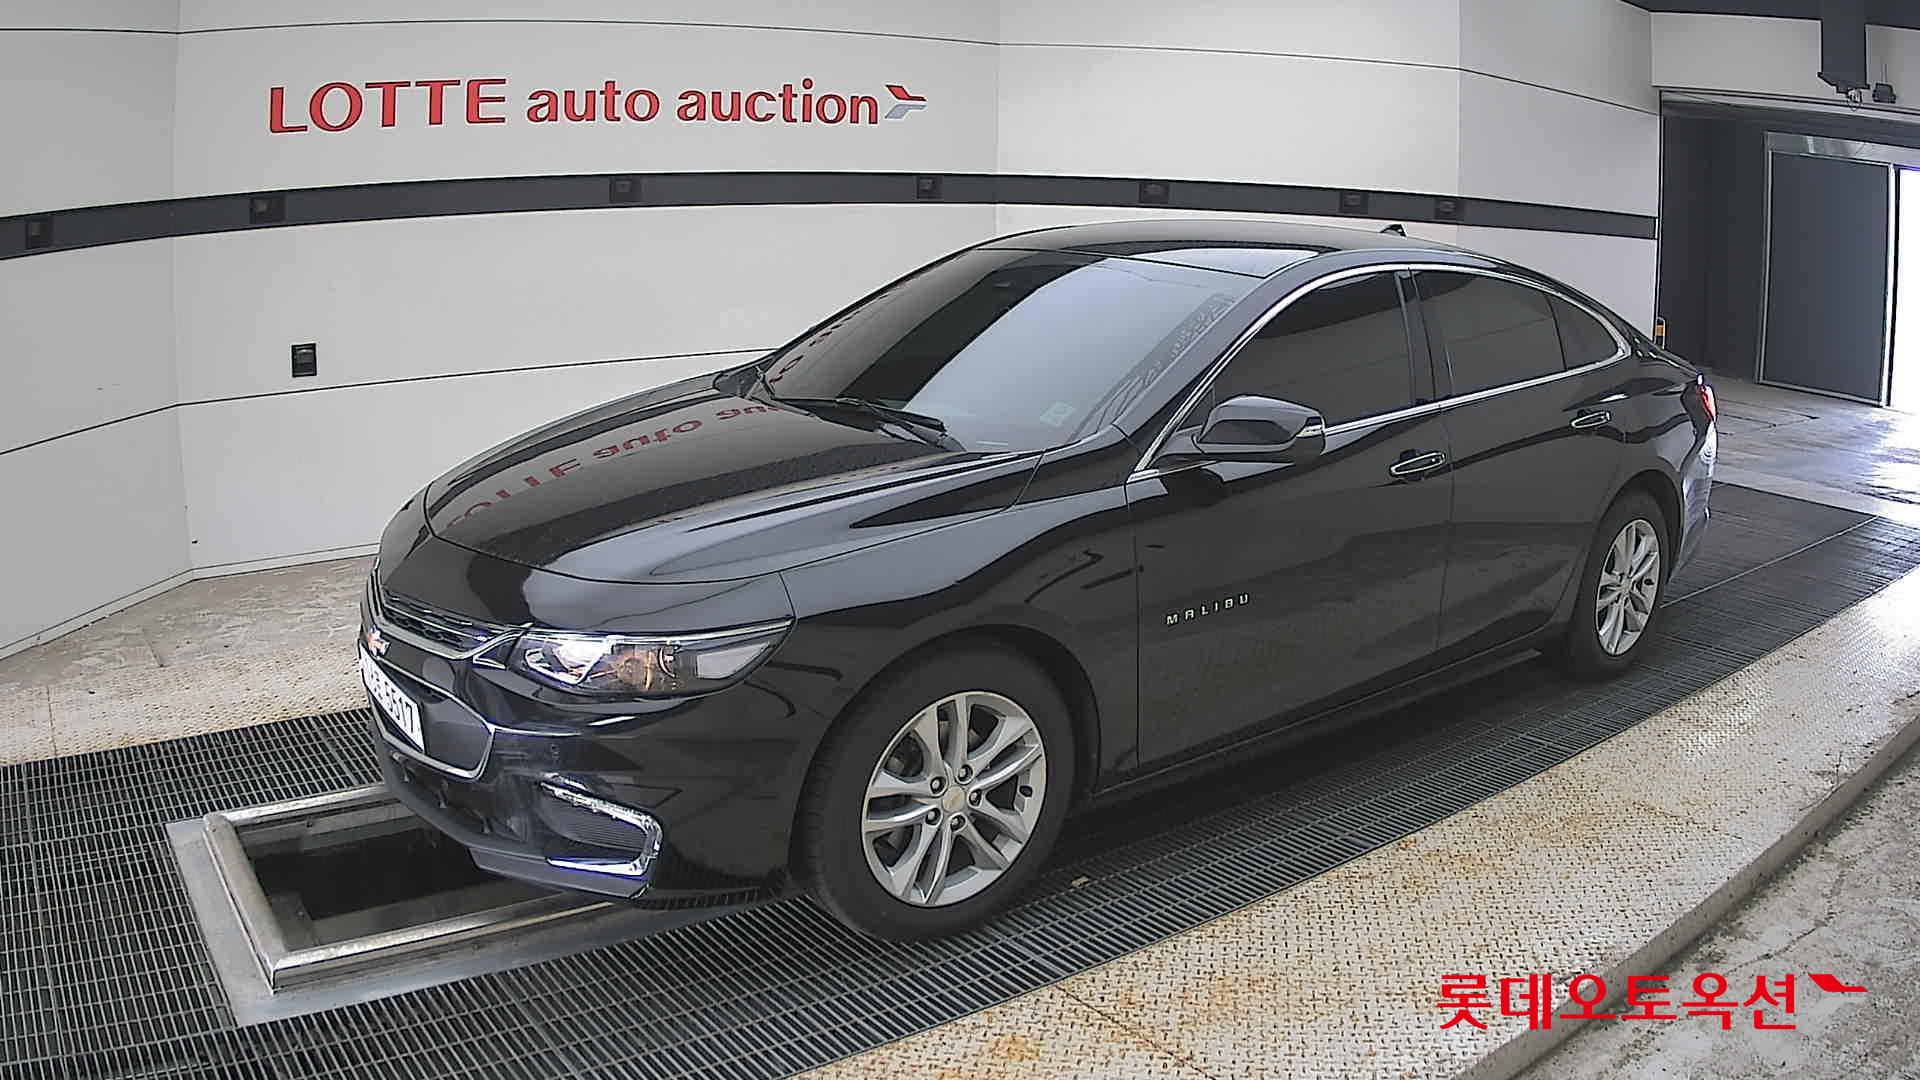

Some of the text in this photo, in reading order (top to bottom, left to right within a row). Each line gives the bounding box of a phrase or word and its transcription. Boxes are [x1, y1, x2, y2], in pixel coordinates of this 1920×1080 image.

[268, 78, 879, 134] LOTTE auto auction
[1166, 593, 1249, 625] MALIBU
